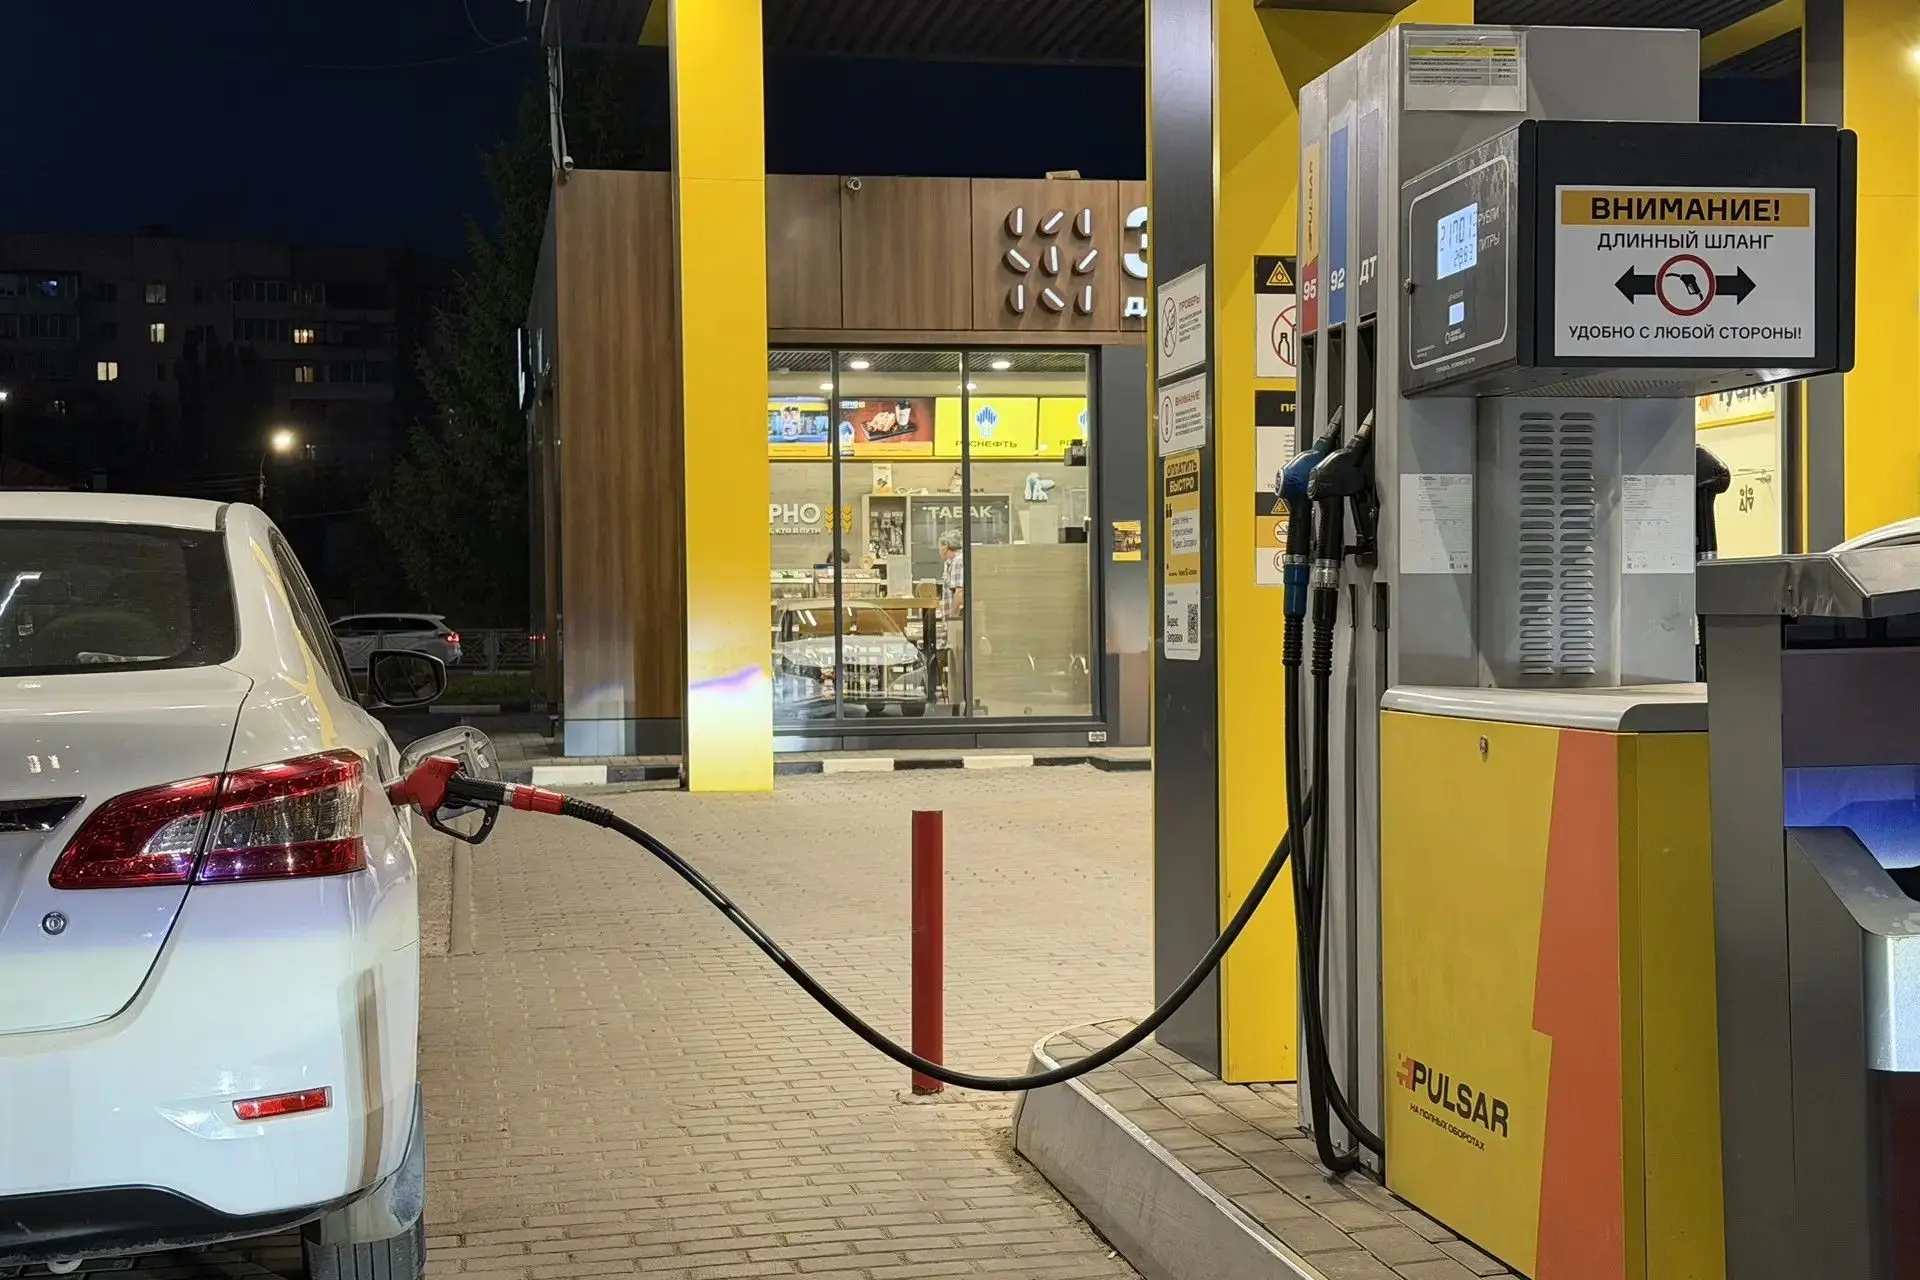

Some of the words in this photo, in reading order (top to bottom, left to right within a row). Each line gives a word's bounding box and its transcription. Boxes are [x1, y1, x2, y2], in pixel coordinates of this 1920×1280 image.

[1591, 197, 1780, 221] ВНИМАНИЕ!
[1597, 230, 1698, 251] ДЛИННЫЙ
[1705, 234, 1774, 250] ШЛАНГ
[1330, 267, 1346, 292] 92
[1359, 255, 1378, 286] ДТ
[1303, 278, 1317, 301] 95
[1568, 326, 1634, 341] УДОБНО
[1639, 326, 1650, 339] С
[1654, 323, 1715, 340] ЛЮБОЙ
[1719, 327, 1802, 340] СТОРОНЫ!
[955, 440, 1018, 448] РСНЕФТЬ
[1166, 459, 1198, 477] ОПЛАТИТЬ
[1169, 476, 1195, 493] БЫСТРО
[930, 506, 993, 519] ТАБАК
[800, 527, 821, 535] ПУТИ
[1411, 1060, 1509, 1138] PULSAR
[1410, 1103, 1419, 1114] НА
[1419, 1110, 1449, 1131] ПОЛНЫХ
[1448, 1124, 1485, 1151] ОБОРОТАХ
